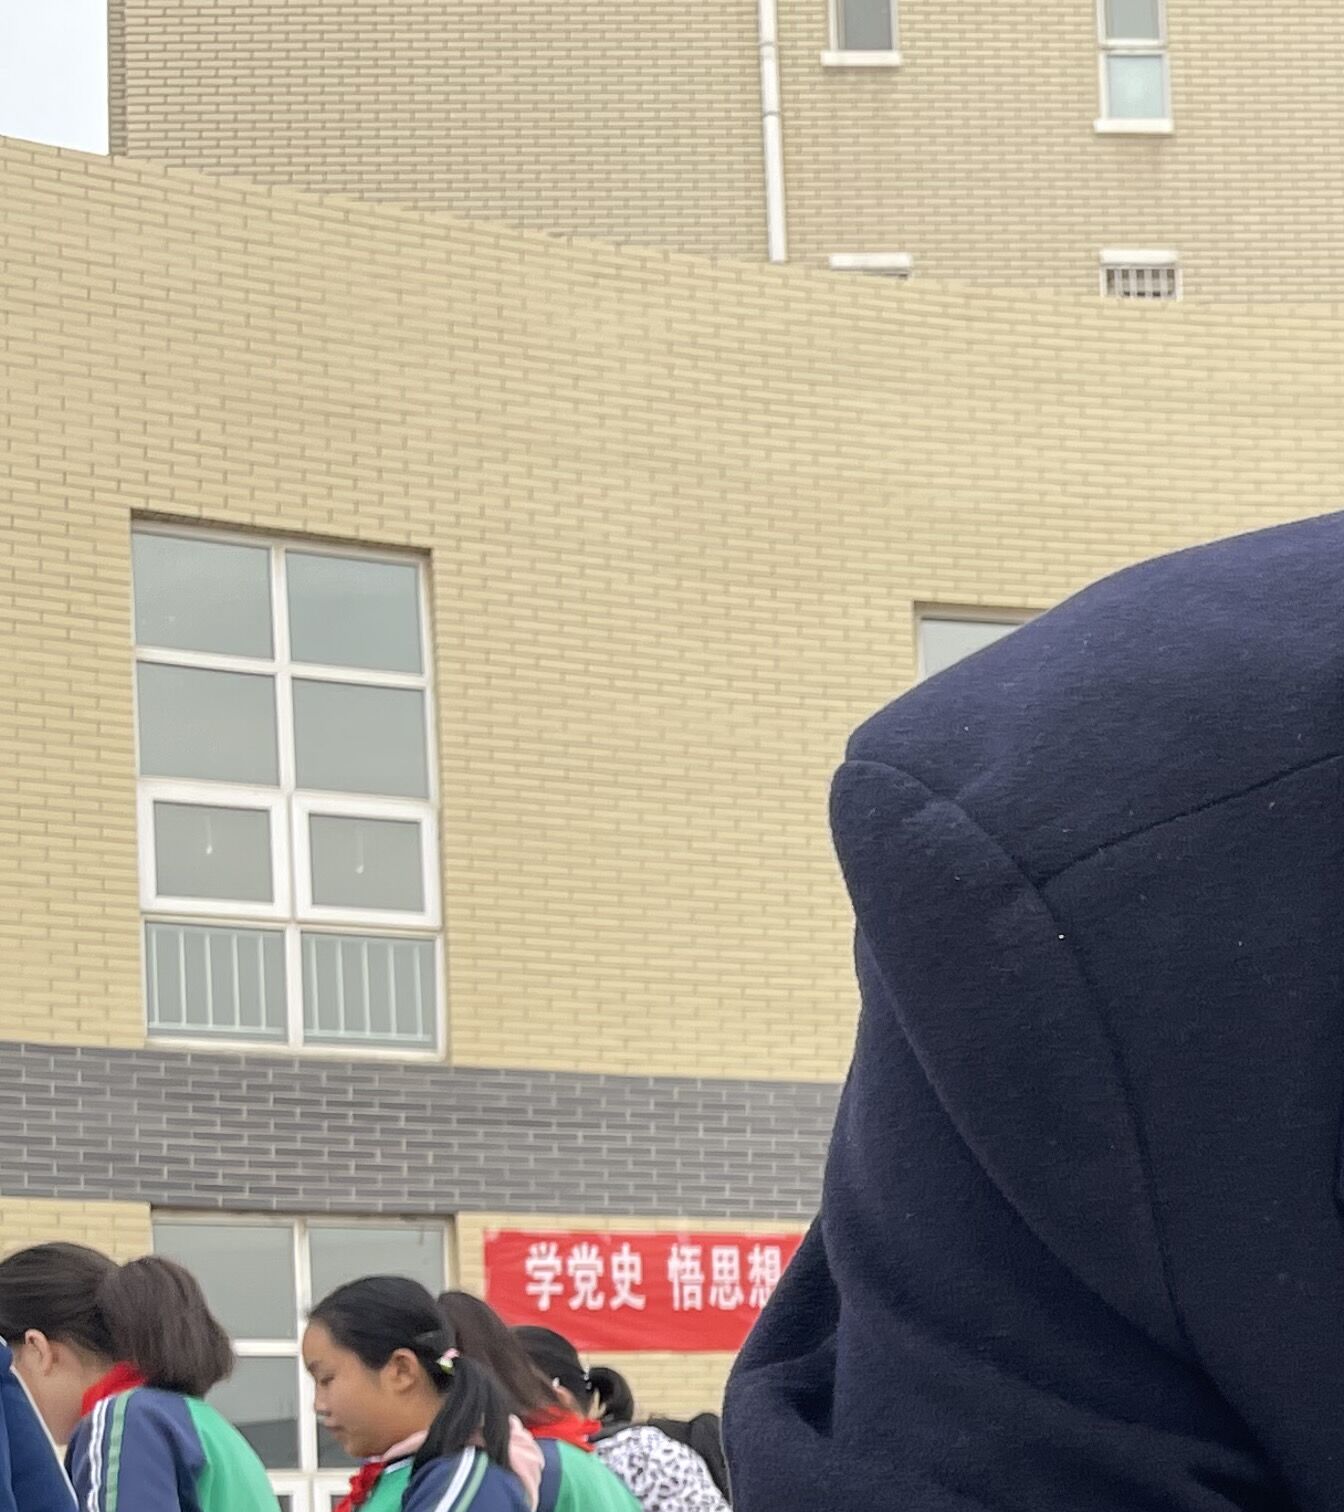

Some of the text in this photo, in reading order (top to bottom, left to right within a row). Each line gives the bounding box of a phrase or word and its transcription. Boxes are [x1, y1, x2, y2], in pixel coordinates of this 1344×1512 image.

[525, 1241, 783, 1312] 学党史 悟思想
